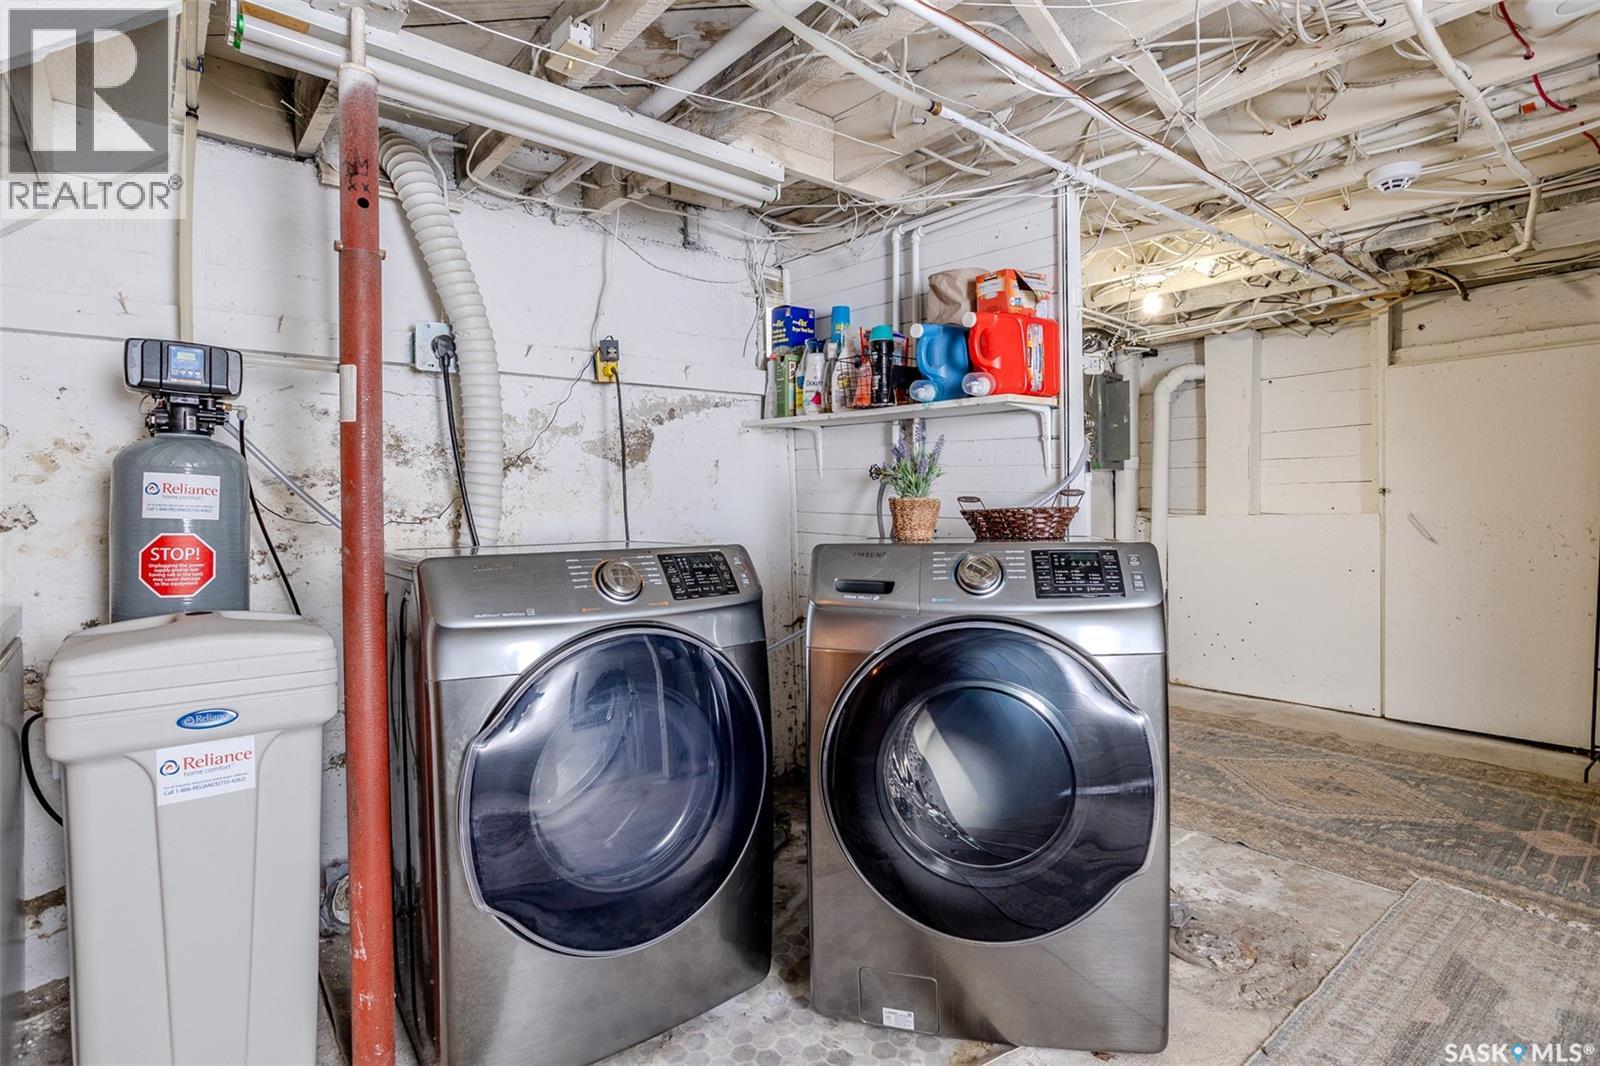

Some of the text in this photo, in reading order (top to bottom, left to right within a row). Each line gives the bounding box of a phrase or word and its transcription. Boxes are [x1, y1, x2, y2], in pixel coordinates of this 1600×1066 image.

[162, 483, 218, 496] Reliance
[150, 547, 200, 561] STOP!
[183, 750, 252, 770] Reliance
[183, 764, 231, 777] home comfort
